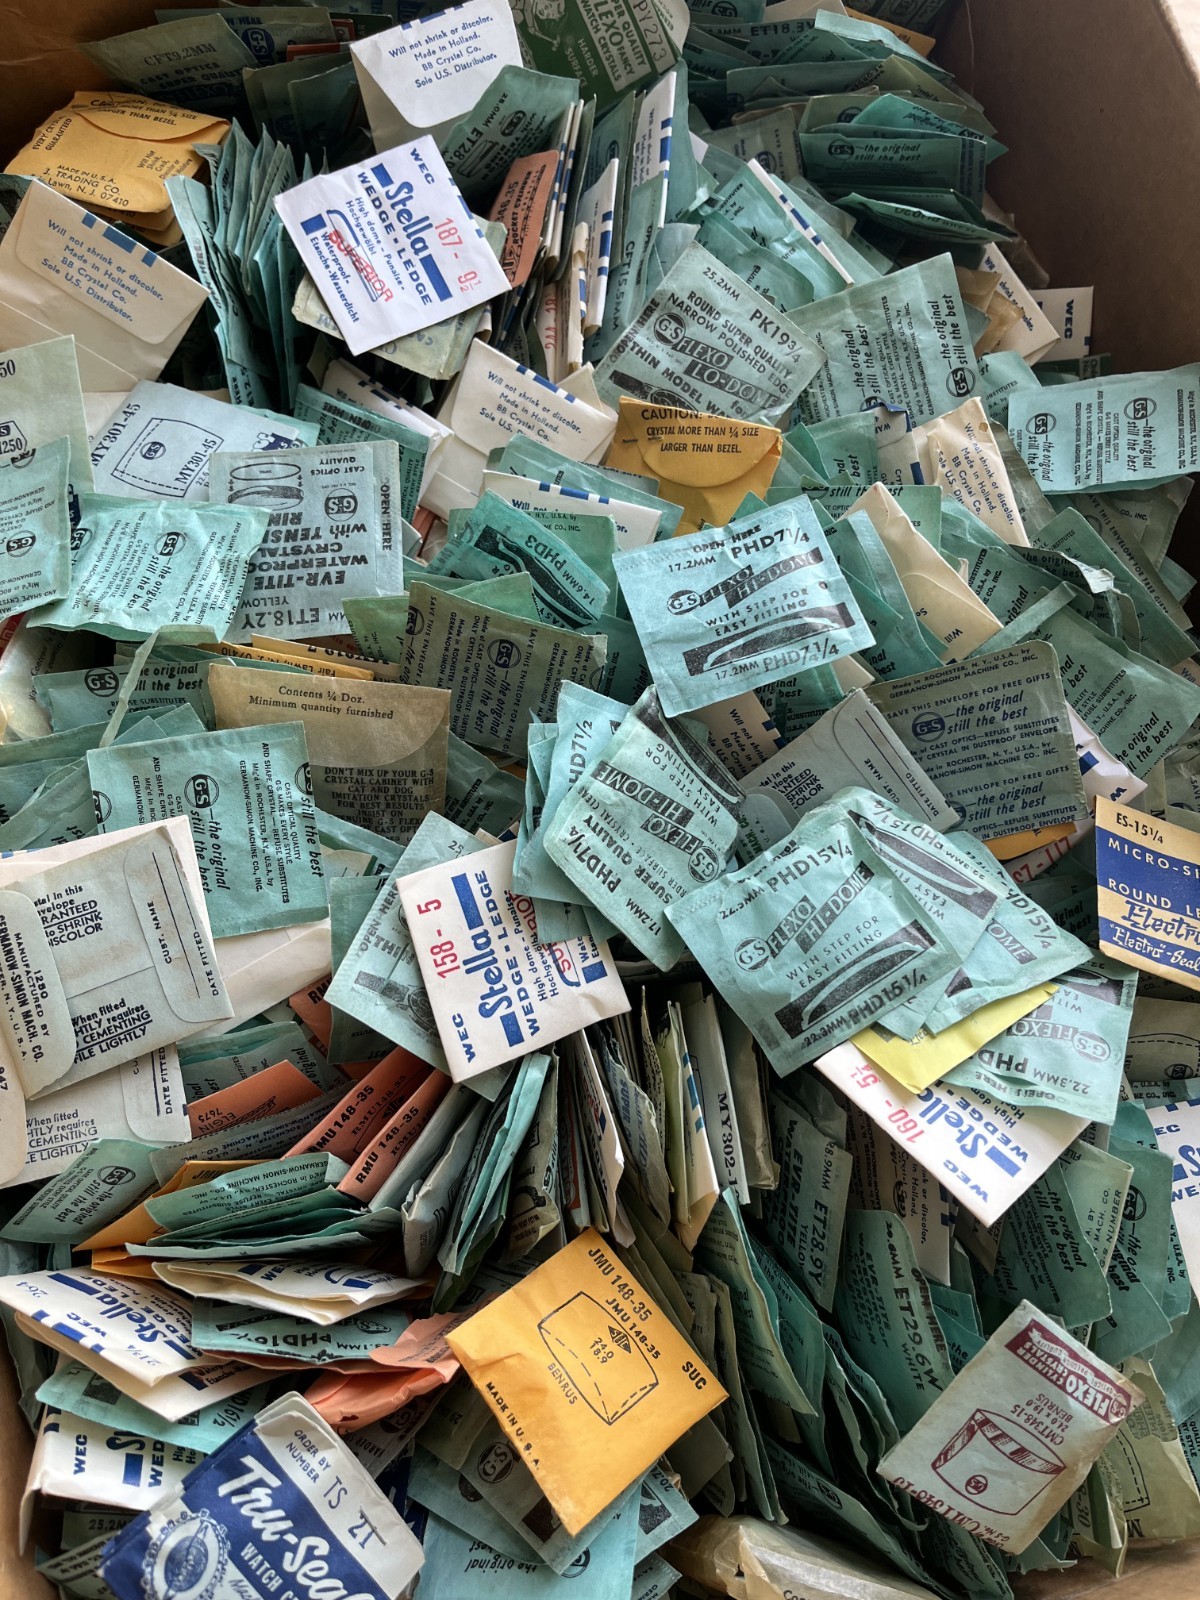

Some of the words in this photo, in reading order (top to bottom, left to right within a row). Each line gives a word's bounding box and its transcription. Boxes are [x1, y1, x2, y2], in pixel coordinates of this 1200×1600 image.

[389, 46, 407, 58] Will
[409, 40, 422, 50] not
[424, 30, 447, 43] shrink
[461, 15, 494, 33] discolor.
[414, 49, 433, 61] Made
[448, 33, 481, 48] Holland.
[622, 21, 646, 66] QUALITY
[415, 75, 433, 88] Sole
[455, 53, 497, 74] Distributor.
[422, 62, 433, 72] BB
[436, 52, 463, 69] Crystal
[465, 46, 482, 58] Co.
[598, 36, 621, 81] CRYSTALS
[618, 46, 634, 75] FANCY
[410, 147, 436, 185] WEC
[854, 153, 874, 161] still
[898, 152, 921, 162] best
[883, 143, 921, 154] original
[55, 170, 99, 189] TRADING
[104, 183, 121, 195] CO.
[57, 164, 79, 175] MADE
[100, 191, 129, 207] 07410
[345, 199, 377, 256] Hochgewölbt
[355, 196, 370, 217] High
[367, 219, 382, 246] dome
[385, 181, 434, 257] Stella
[435, 218, 464, 247] 187
[357, 171, 396, 235] WEDGE
[396, 247, 433, 306] LEDGE
[48, 219, 67, 237] Will
[69, 235, 84, 248] not
[86, 246, 114, 267] shrink
[129, 273, 164, 301] discolor.
[61, 257, 74, 269] BB
[77, 267, 109, 291] Crystal
[64, 244, 88, 264] Made
[103, 270, 139, 297] Holland.
[327, 229, 394, 302] SUPERIOR
[42, 258, 62, 276] Sole
[64, 272, 82, 289] U.S.
[86, 285, 134, 321] Distributor.
[702, 266, 741, 301] 25.2MM
[927, 301, 947, 340] original
[942, 294, 957, 317] best
[1064, 298, 1074, 339] WEC
[667, 292, 717, 334] NARROW
[718, 331, 766, 375] POLISHED
[768, 372, 794, 399] EDGE
[687, 290, 721, 321] ROUND
[721, 318, 753, 347] SUPER
[754, 343, 793, 380] QUALITY
[950, 323, 962, 340] the
[629, 342, 658, 370] THIN
[662, 366, 703, 405] MODEL
[487, 370, 503, 386] Will
[504, 381, 517, 394] not
[518, 388, 540, 408] shrink
[552, 411, 582, 434] discolor.
[90, 403, 141, 467] MY301-45
[509, 410, 535, 432] Crystal
[530, 411, 560, 434] Holland.
[647, 426, 676, 436] CRYSTAL
[677, 426, 702, 436] MORE
[704, 427, 726, 436] THAN
[741, 428, 759, 437] SIZE
[174, 438, 217, 485] MY301-45
[319, 456, 356, 465] QUALITY
[661, 443, 689, 452] LARGER
[692, 443, 713, 453] THAN
[717, 444, 742, 454] BEZEL.
[310, 466, 341, 476] OPTICS
[344, 466, 365, 474] CAST
[380, 484, 391, 515] OPEN
[329, 522, 367, 535] with
[382, 522, 392, 551] HERE
[261, 542, 344, 557] CRYSTAL
[667, 555, 717, 573] 17.2MM
[253, 570, 346, 591] EVR-TITE
[241, 595, 289, 609] YELLOW
[241, 607, 320, 630] ET18.2Y
[705, 610, 741, 628] WITH
[745, 597, 776, 614] STEP
[715, 619, 748, 637] EASY
[754, 599, 808, 628] FITTING
[714, 662, 760, 681] 17.2MM
[249, 695, 298, 709] Minimum
[300, 701, 343, 716] quantity
[346, 705, 394, 720] furnished
[278, 684, 325, 699] Contents
[340, 693, 366, 705] Doz.
[935, 691, 980, 709] ENVELOPE
[1002, 679, 1023, 692] FREE
[1025, 672, 1051, 685] GIFTS
[978, 691, 1024, 713] original
[947, 720, 971, 735] still
[976, 715, 996, 728] the
[1002, 707, 1028, 725] best
[1014, 715, 1060, 731] SUBSTITUTES
[1020, 726, 1059, 740] ENVELOPE
[324, 776, 366, 785] CRYSTAL
[369, 778, 407, 786] CABINET
[392, 770, 416, 778] YOUR
[209, 843, 230, 891] original
[583, 814, 633, 865] QUALITY
[633, 866, 673, 904] SUPER
[65, 884, 83, 895] this
[416, 898, 442, 915] 5
[480, 870, 508, 940] LEDGE
[1108, 877, 1172, 909] ROUND
[57, 912, 103, 935] SHRINK
[147, 900, 163, 930] NAME
[626, 897, 662, 936] 17.2MM
[155, 939, 173, 965] CUST.
[786, 956, 820, 981] WITH
[823, 931, 851, 955] STEP
[855, 915, 880, 933] FOR
[799, 965, 830, 989] EASY
[836, 930, 883, 964] FITTING
[14, 932, 44, 1018] MANUFACTURED
[462, 928, 514, 1019] Stella
[505, 954, 541, 1037] WEDGE
[83, 1010, 151, 1045] CEMENTING
[99, 1026, 147, 1053] LIGHTLY
[451, 1012, 477, 1063] WEC
[334, 1085, 374, 1129] 148-35
[888, 1105, 925, 1144] 160
[355, 1151, 379, 1184] RMU
[378, 1106, 419, 1149] 148-35
[956, 1095, 1029, 1164] WEDGE
[943, 1159, 990, 1204] WEC
[1106, 1189, 1122, 1243] NUMBER
[588, 1247, 616, 1278] JMU
[610, 1274, 653, 1322] 148-35
[99, 1288, 168, 1343] Stella
[605, 1297, 630, 1323] JMU
[629, 1322, 662, 1360] 148-35
[546, 1362, 578, 1406] BENRUS
[681, 1360, 708, 1391] SUC
[901, 1342, 926, 1392] WHITE
[485, 1381, 510, 1414] MADE
[1035, 1393, 1074, 1424] BENRUS
[1066, 1375, 1109, 1416] FLEXO
[73, 1433, 88, 1475] WEC
[285, 1440, 321, 1484] NUMBER
[293, 1428, 318, 1459] ORDER
[316, 1455, 331, 1472] BY
